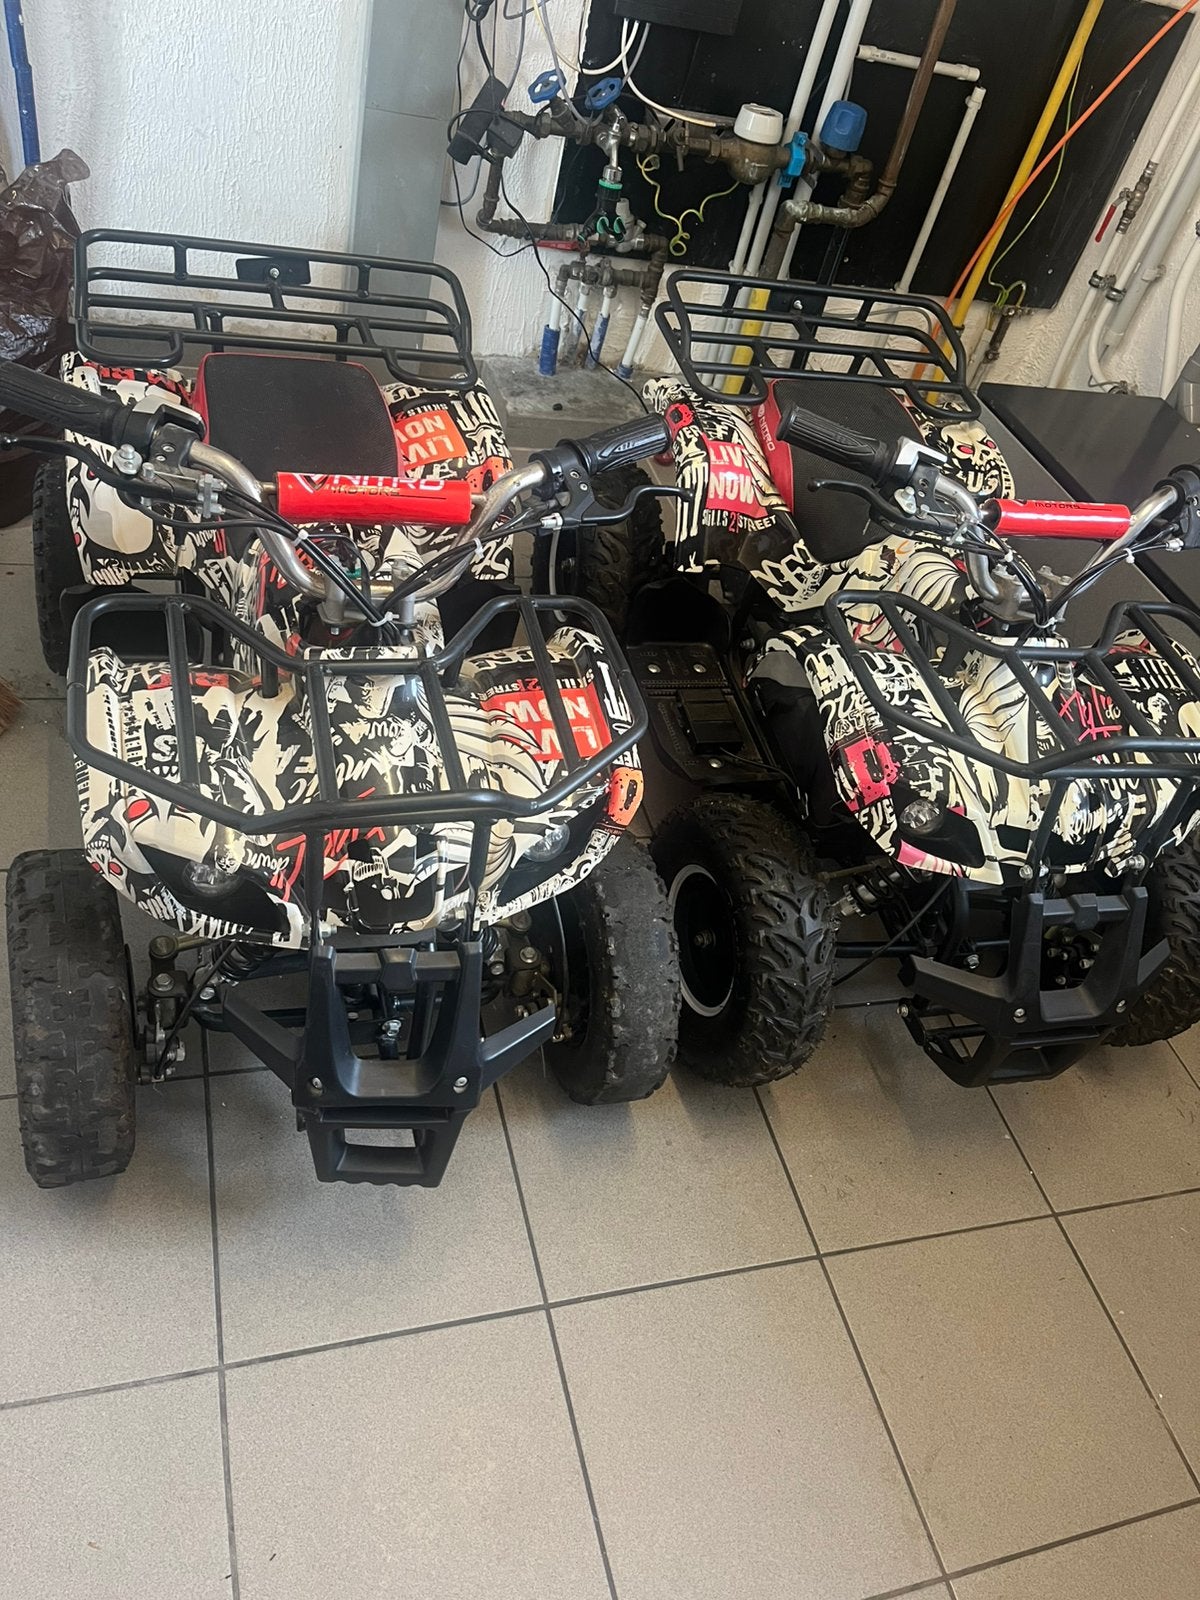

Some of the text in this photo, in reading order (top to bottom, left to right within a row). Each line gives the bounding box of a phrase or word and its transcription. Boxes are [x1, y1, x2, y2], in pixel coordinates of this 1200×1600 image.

[758, 414, 776, 452] NITRO
[406, 434, 456, 466] LIV
[709, 445, 751, 468] LIV
[1034, 501, 1081, 510] MOTORS
[738, 514, 777, 532] STREET
[470, 681, 521, 700] STREET
